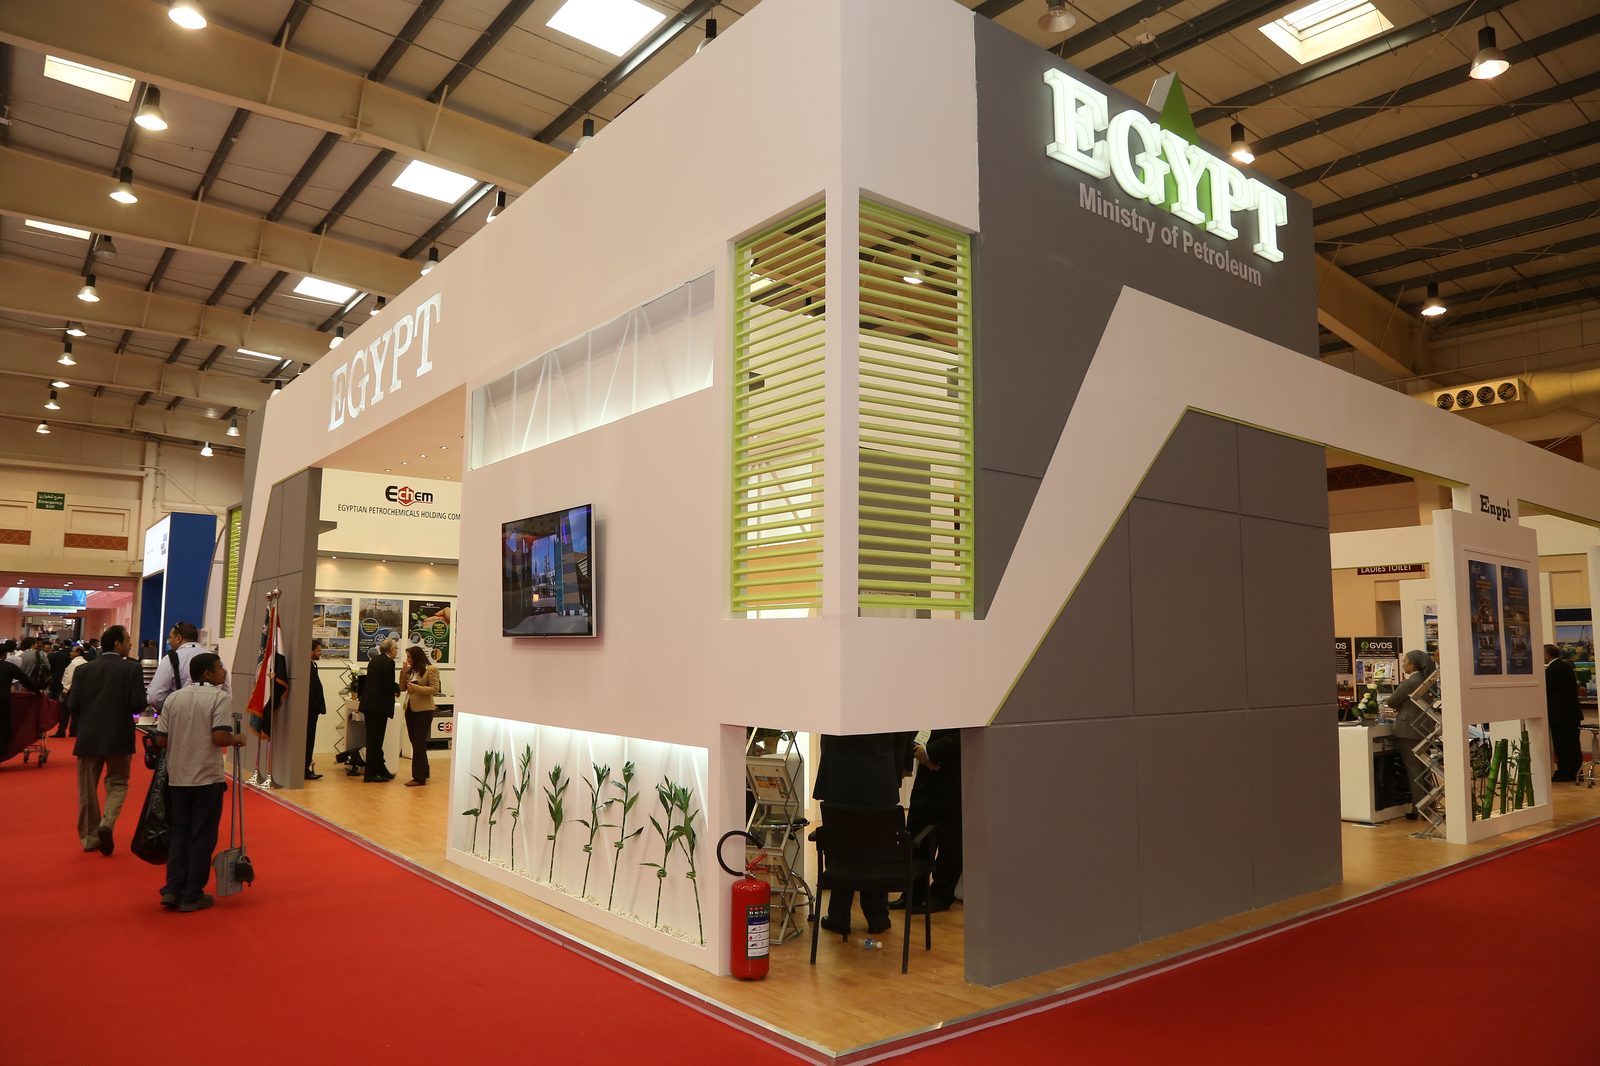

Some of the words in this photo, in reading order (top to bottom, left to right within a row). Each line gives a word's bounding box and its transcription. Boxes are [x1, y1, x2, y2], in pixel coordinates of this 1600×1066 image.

[1043, 67, 1288, 263] EGYPT
[1079, 182, 1156, 244] Ministry
[1161, 225, 1179, 249] of
[1183, 230, 1262, 287] Petroleum
[327, 291, 442, 432] EGYPT
[338, 503, 367, 513] EGYPTIAN
[368, 506, 420, 518] PETROCHEMICALS
[421, 511, 446, 519] HOLDING
[1480, 494, 1511, 522] Enppi
